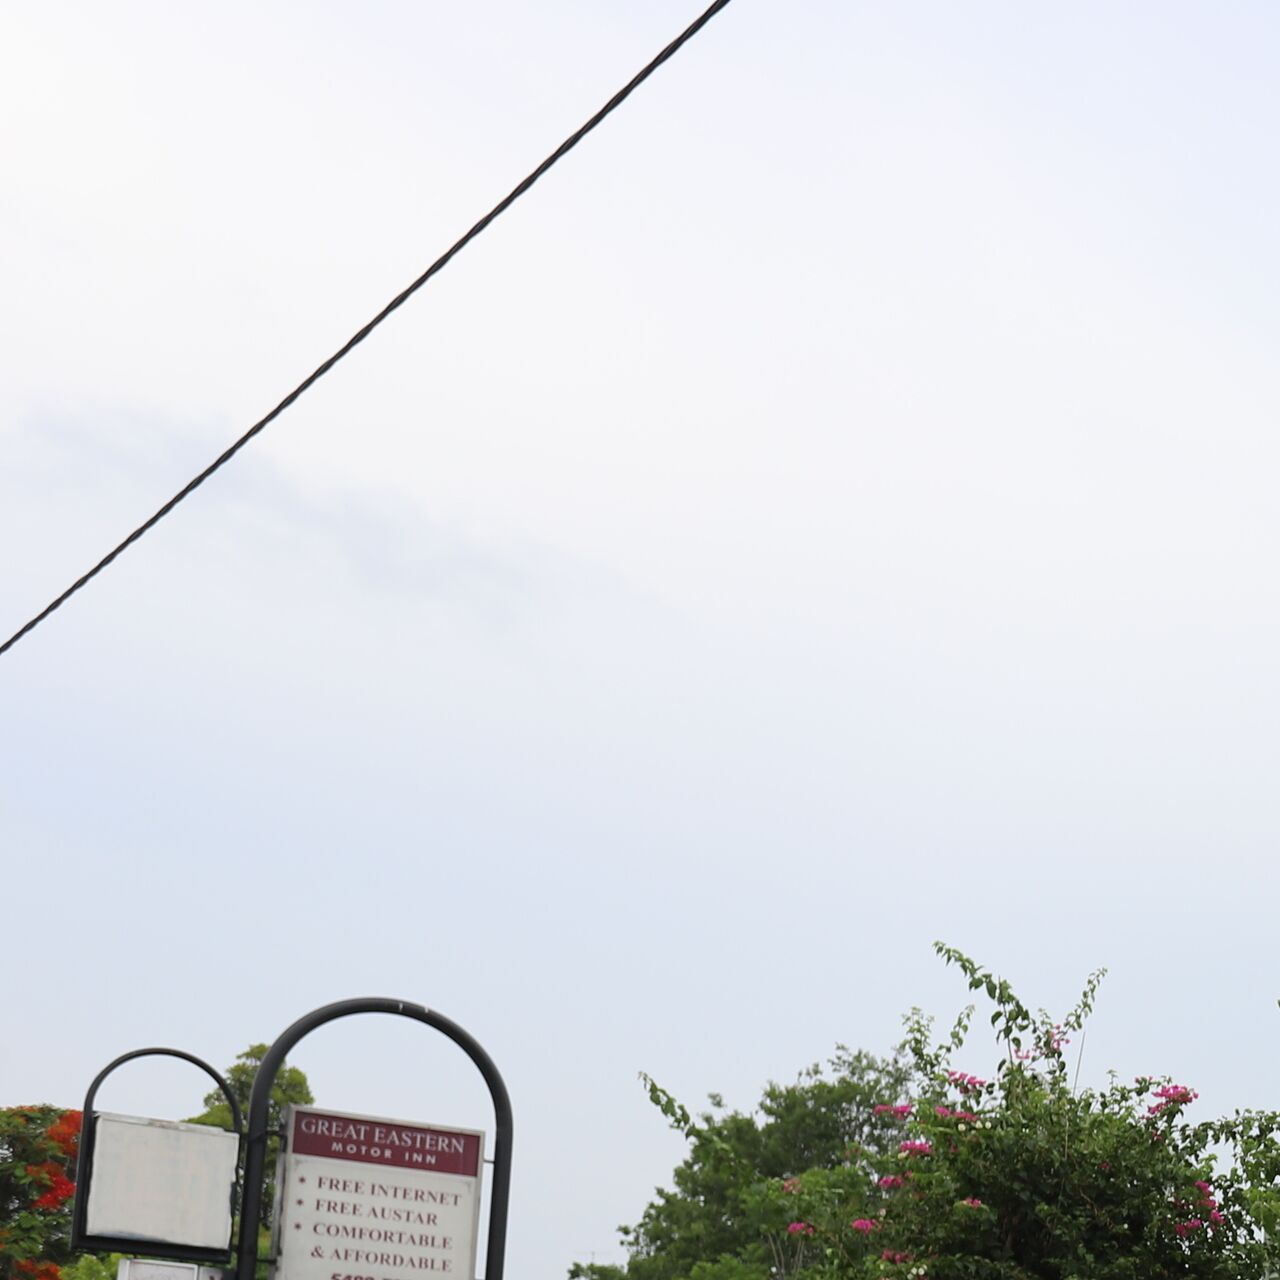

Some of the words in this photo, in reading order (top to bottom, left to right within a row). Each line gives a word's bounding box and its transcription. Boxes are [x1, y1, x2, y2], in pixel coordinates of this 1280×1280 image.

[301, 1118, 369, 1140] GREAT
[374, 1128, 464, 1153] EASTERN
[331, 1141, 392, 1158] MOTOR
[405, 1153, 437, 1165] INN
[317, 1176, 365, 1195] FREE
[371, 1183, 462, 1207] INTERNET
[315, 1199, 363, 1216] FREE
[368, 1206, 438, 1226] AUSTAR
[313, 1223, 453, 1250] COMFORTABLE
[310, 1246, 324, 1259] &
[329, 1248, 452, 1273] AFFORDABLE
